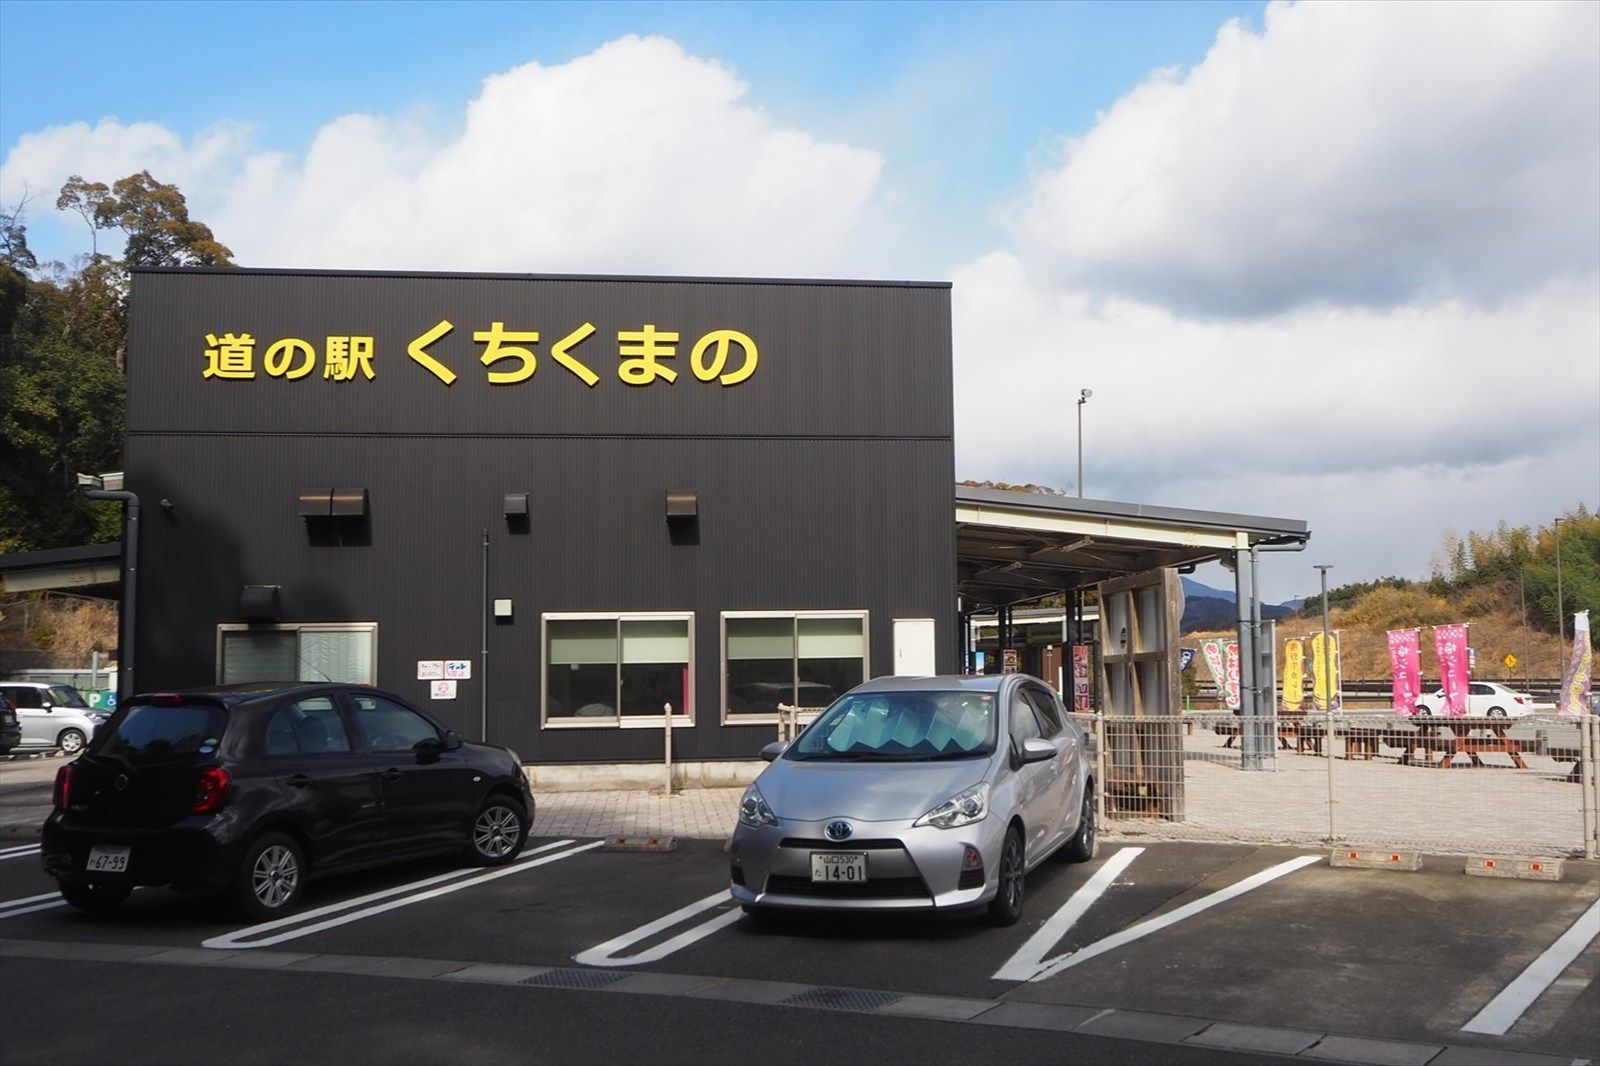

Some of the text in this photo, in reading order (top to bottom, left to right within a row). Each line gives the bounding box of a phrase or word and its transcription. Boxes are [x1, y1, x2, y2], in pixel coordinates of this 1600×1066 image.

[203, 320, 758, 385] 道の駅 くちくまの
[88, 693, 101, 708] P
[95, 855, 126, 870] 67-99
[826, 865, 862, 881] 14-01
